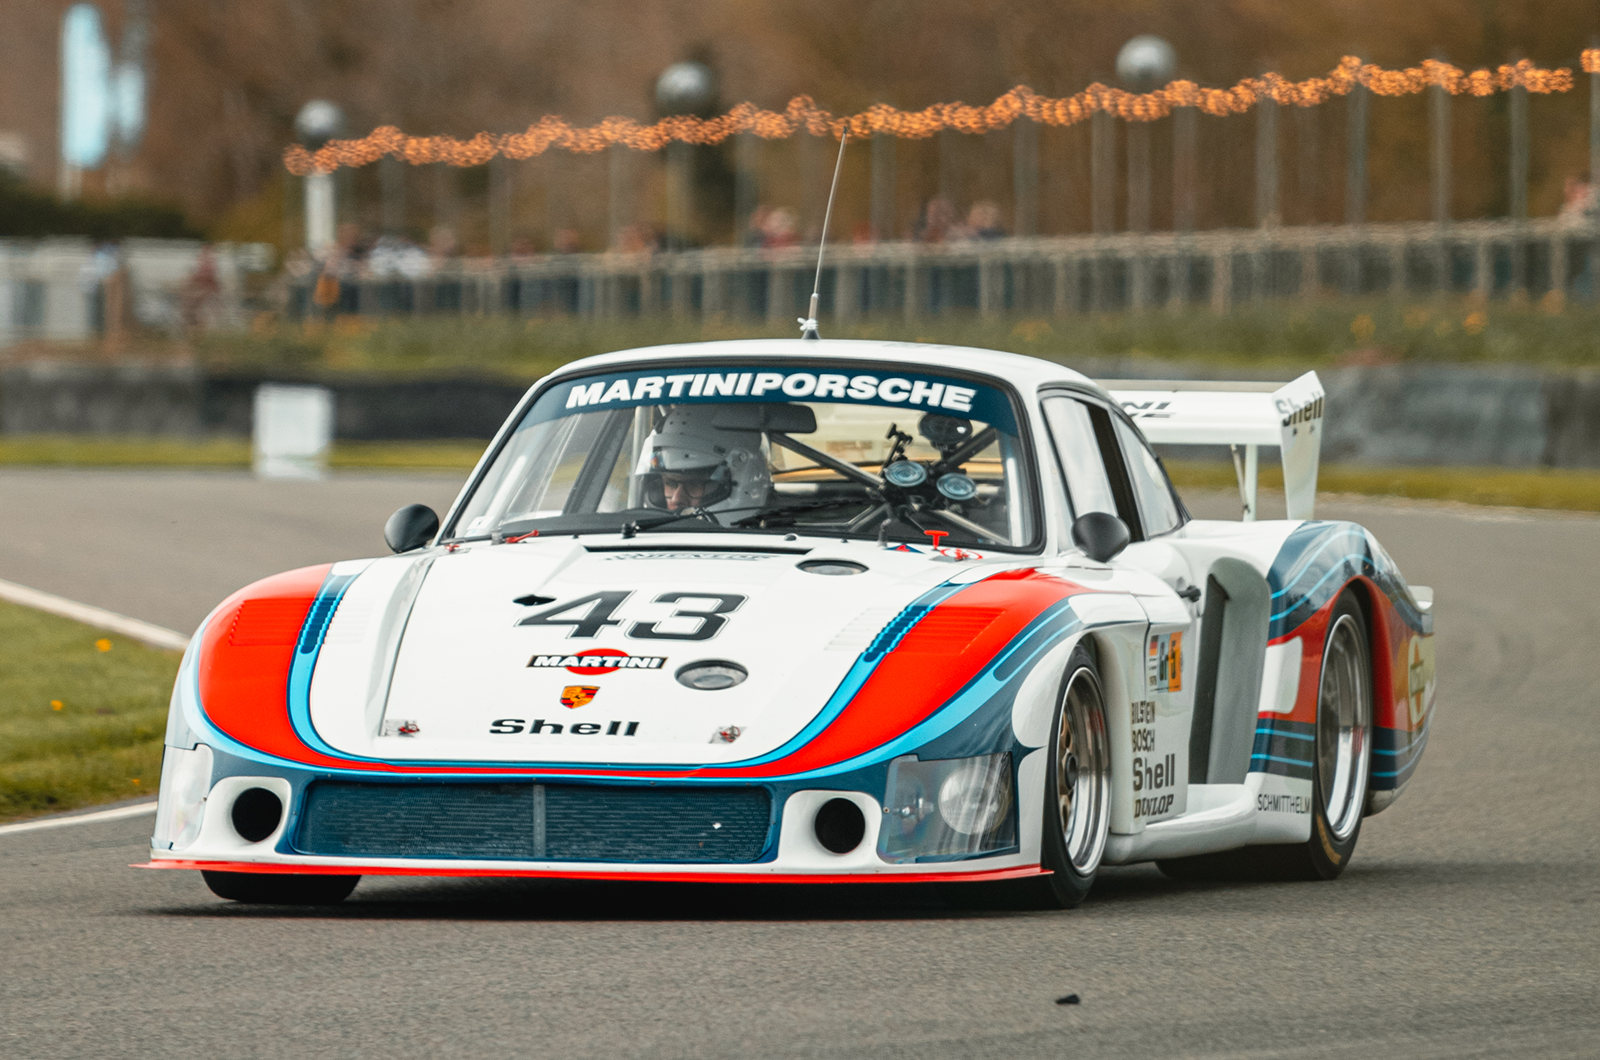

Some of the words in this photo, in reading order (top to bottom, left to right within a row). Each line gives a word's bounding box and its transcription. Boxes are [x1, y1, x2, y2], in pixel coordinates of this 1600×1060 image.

[1275, 391, 1323, 427] Shell
[513, 590, 749, 642] 43
[533, 655, 661, 669] MARTINI
[489, 718, 641, 737] Shell
[1132, 728, 1156, 753] BOSCH
[1132, 753, 1175, 792] Shell
[1134, 794, 1175, 819] DUNLOP
